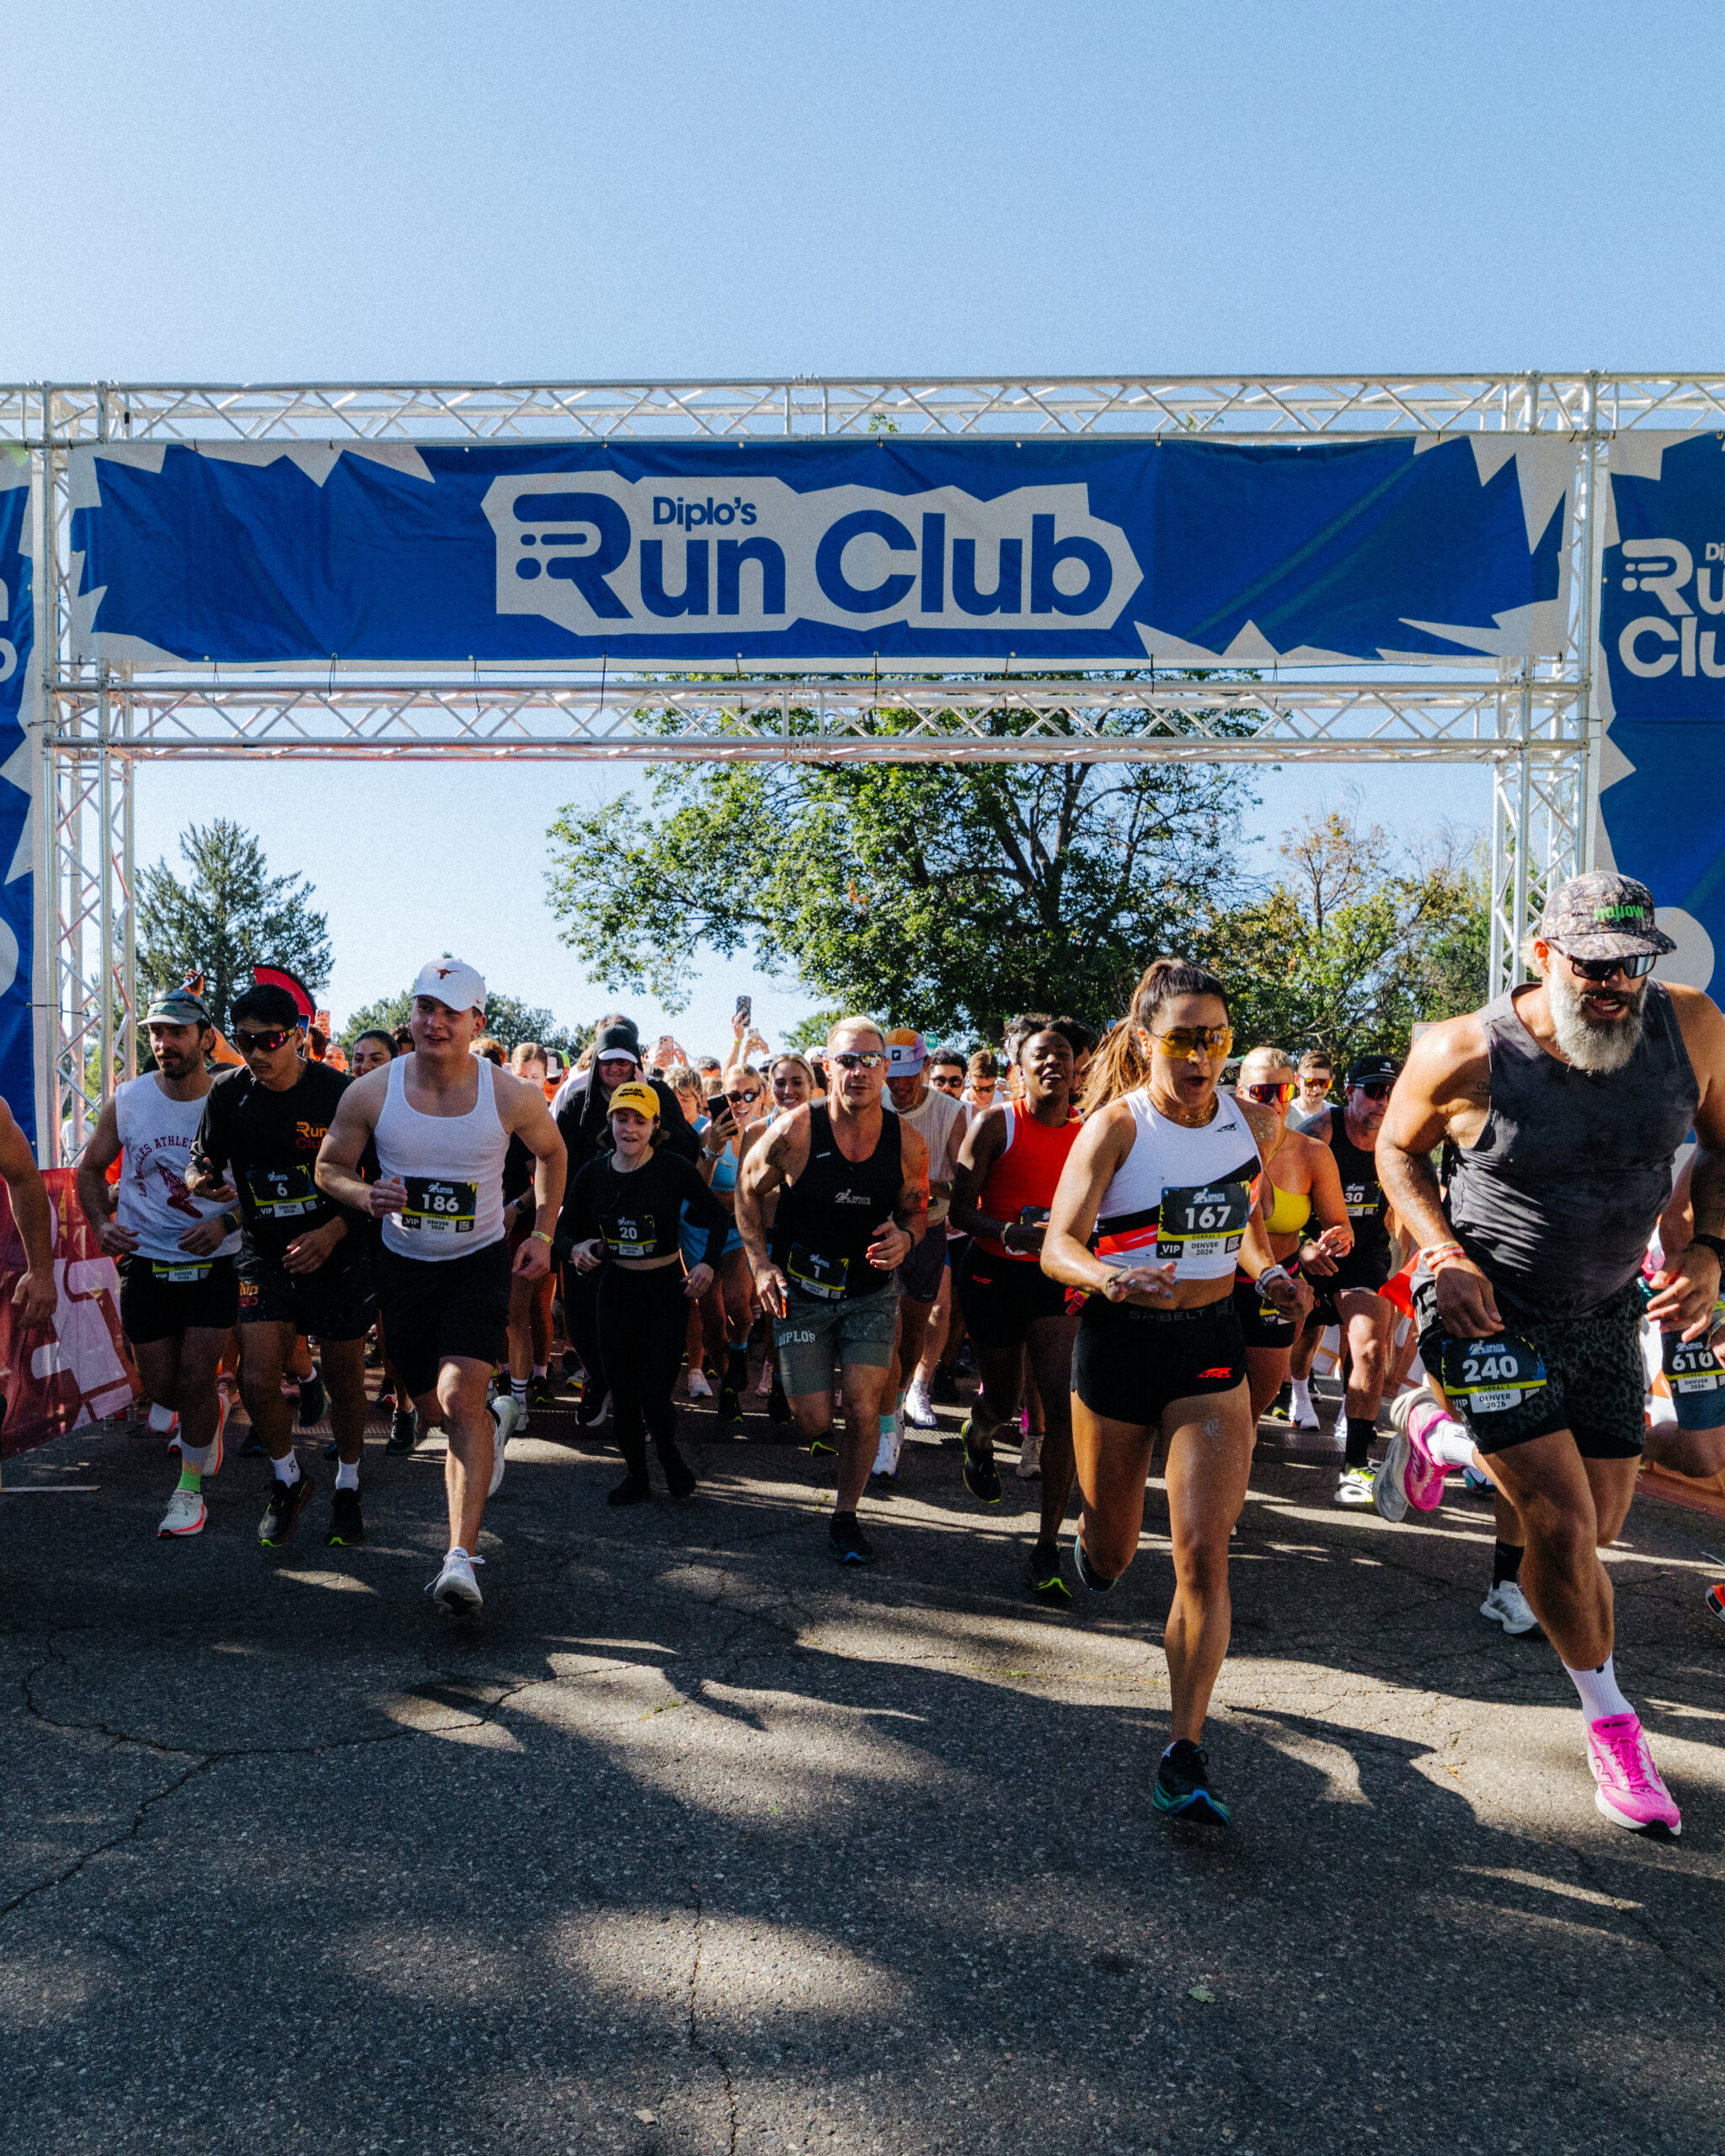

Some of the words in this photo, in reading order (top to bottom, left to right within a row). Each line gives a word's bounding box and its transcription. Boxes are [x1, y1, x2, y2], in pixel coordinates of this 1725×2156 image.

[653, 496, 757, 532] Diplo's
[512, 492, 787, 620] Run
[814, 509, 1113, 617] Club
[1706, 542, 1725, 565] Di
[296, 1121, 328, 1138] Run
[296, 1137, 323, 1150] Clu
[277, 1182, 288, 1197] 6
[260, 1206, 274, 1215] VIP
[422, 1193, 459, 1213] 186
[1185, 1205, 1231, 1230] 167
[619, 1226, 638, 1241] 20
[1162, 1245, 1181, 1254] VIP
[814, 1265, 820, 1278] 1
[1461, 1355, 1519, 1383] 240
[1672, 1351, 1714, 1371] 610
[1479, 1393, 1511, 1402] DENVER
